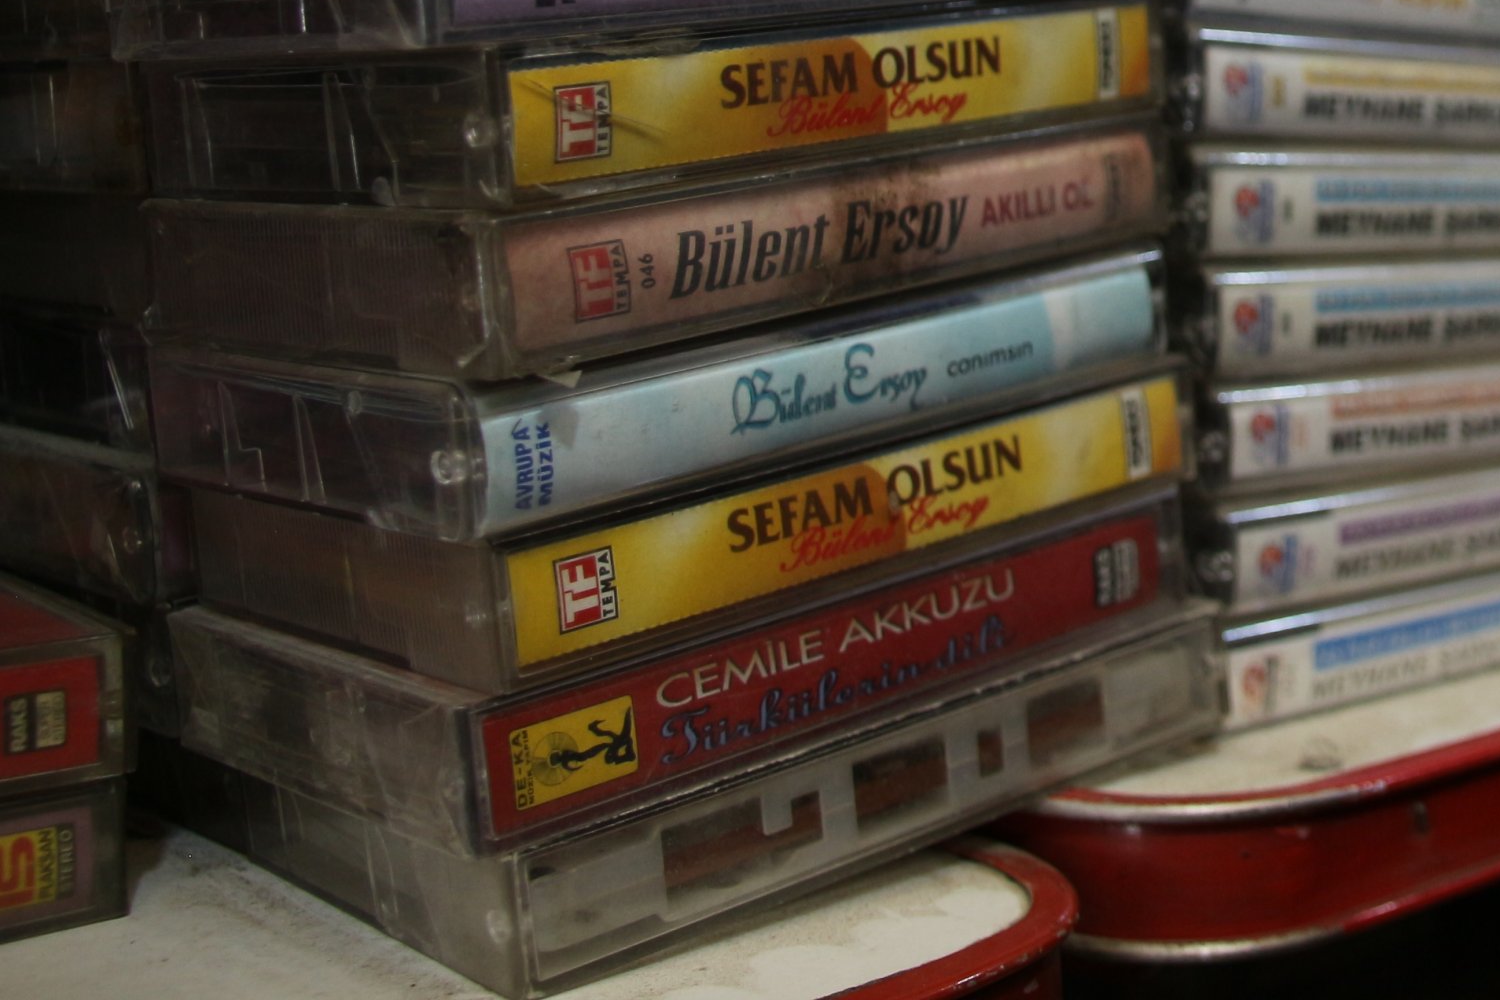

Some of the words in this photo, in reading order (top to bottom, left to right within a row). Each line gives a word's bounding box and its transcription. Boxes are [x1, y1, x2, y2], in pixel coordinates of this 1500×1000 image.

[720, 53, 858, 108] SEFAM
[872, 36, 1003, 89] OLSUN
[766, 93, 884, 137] Bülent
[889, 81, 968, 124] Ersoy
[596, 86, 609, 154] TEMPA
[609, 244, 628, 310] TEMPA
[637, 254, 656, 289] 046
[669, 213, 830, 300] Bülent
[840, 196, 969, 265] Ersoy
[981, 188, 1056, 228] AKILLI
[730, 368, 838, 435] Bülent
[844, 342, 927, 411] Ersoy
[514, 424, 533, 510] AVRUPA
[726, 476, 873, 553] SEFAM
[886, 435, 1022, 506] OLSUN
[780, 514, 900, 573] Bülent
[908, 495, 990, 536] Ersoy
[597, 552, 616, 618] TEMPA
[655, 631, 825, 708] CEMİLE
[838, 568, 1015, 653] AKKUZU
